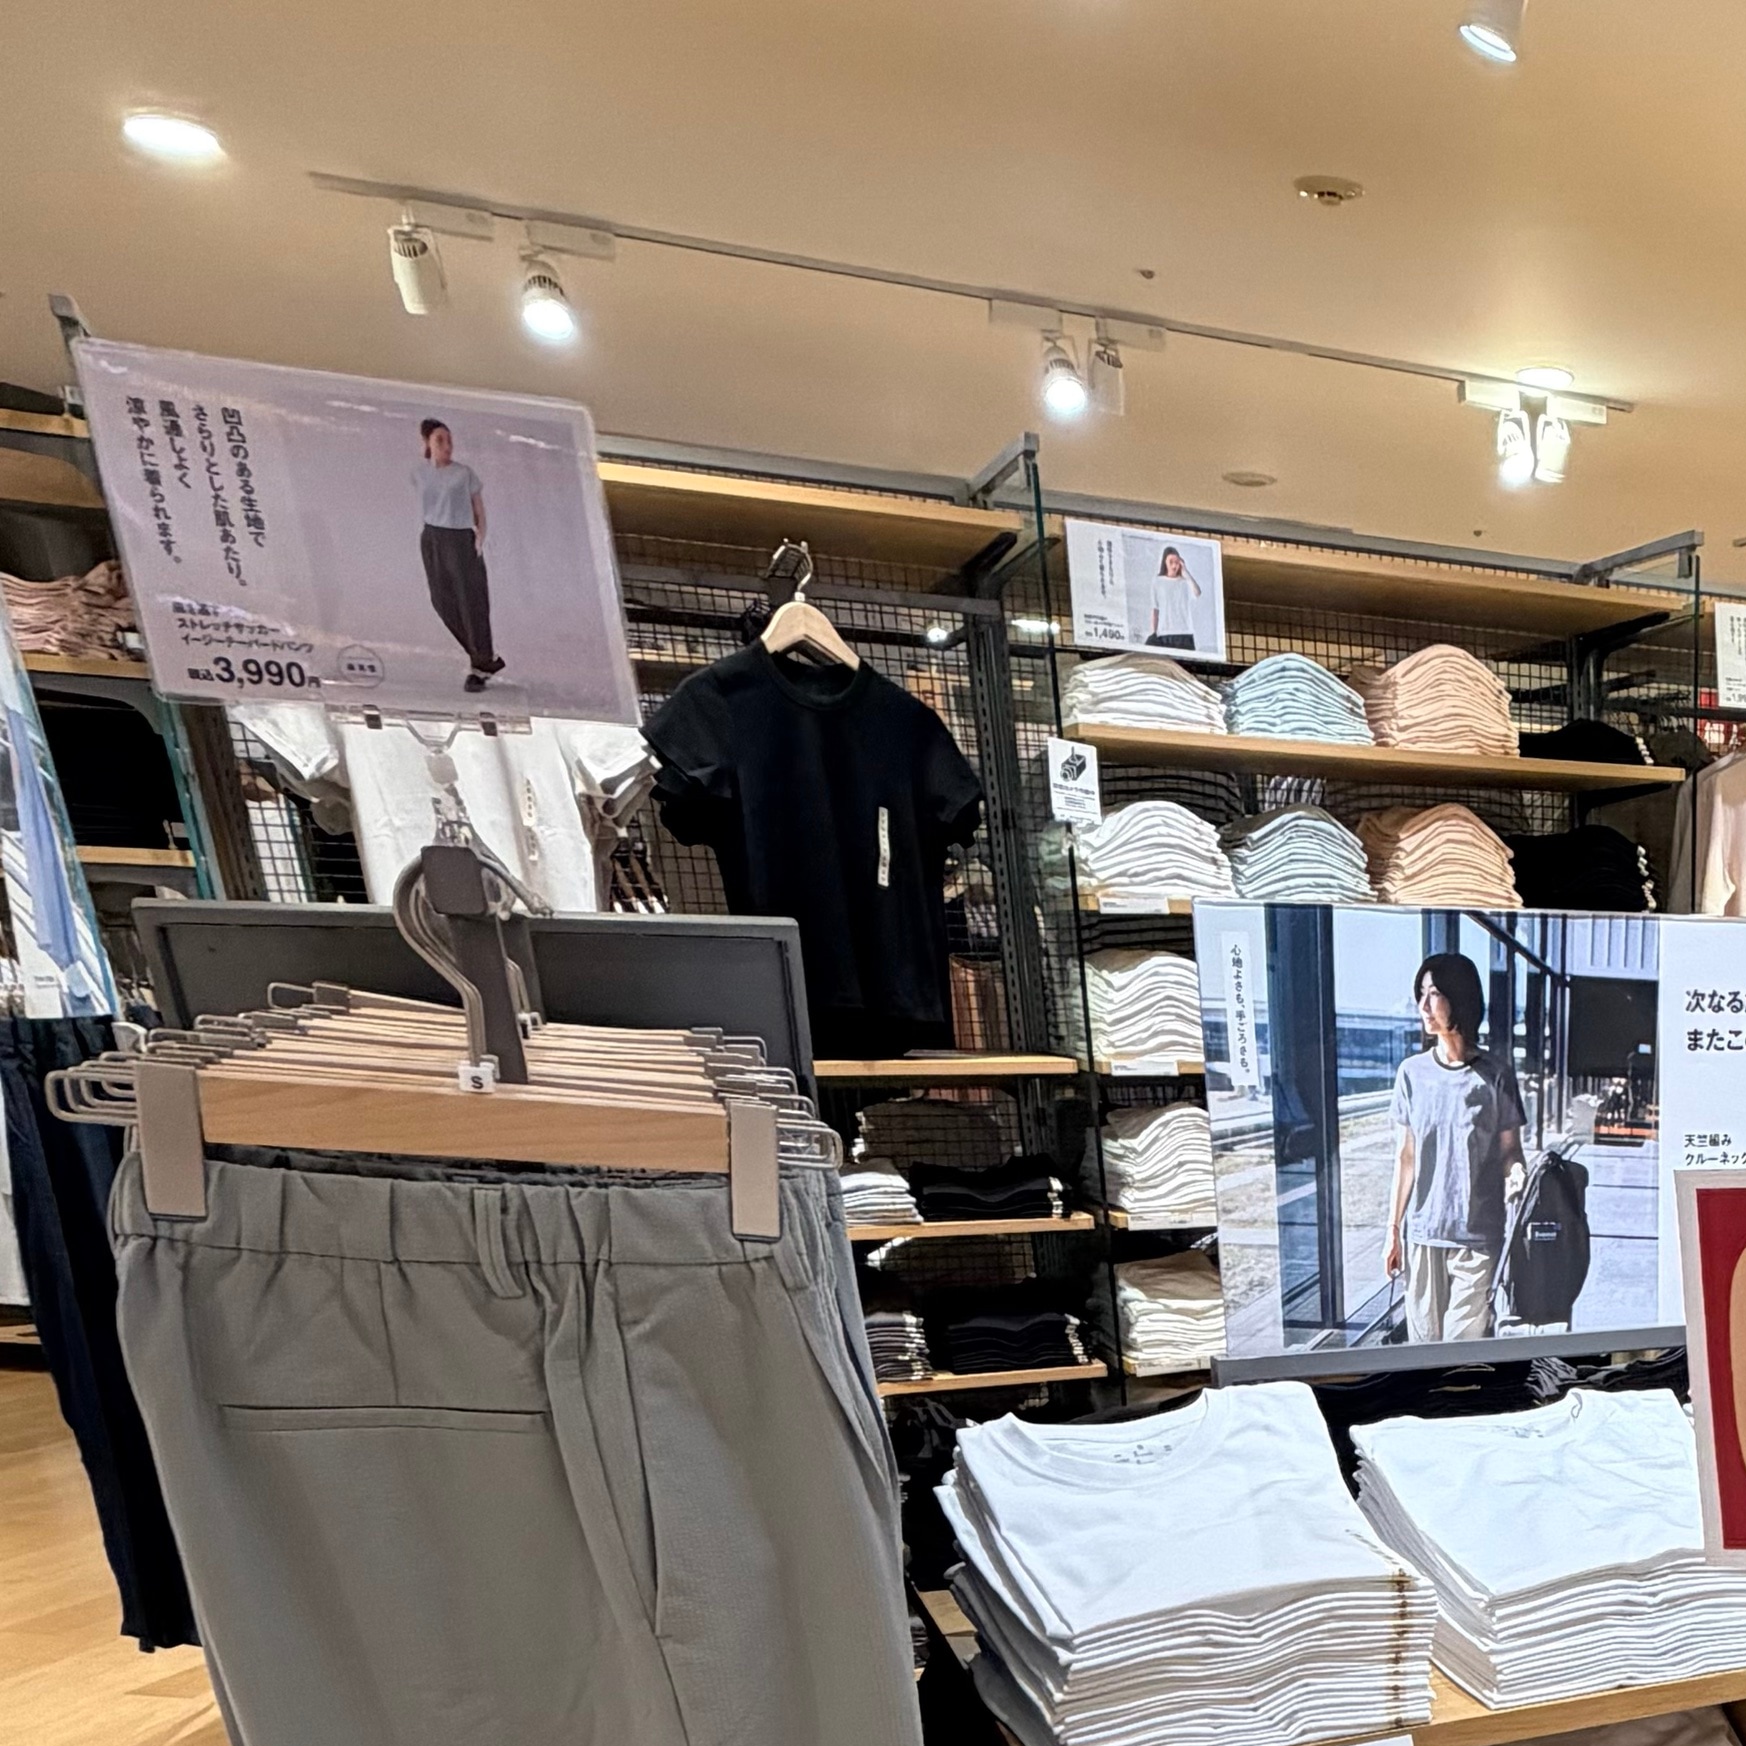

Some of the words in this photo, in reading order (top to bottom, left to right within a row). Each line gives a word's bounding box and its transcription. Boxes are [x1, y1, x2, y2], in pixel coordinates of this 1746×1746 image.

[126, 395, 182, 564] 涼やかに着られます。
[159, 399, 192, 489] 風通しよく
[192, 404, 247, 587] さらりとした肌あたり。
[221, 406, 266, 548] 凹凸のある生地で
[1230, 943, 1251, 1074] 心地よさも、手ごろさも。
[470, 1075, 484, 1090] S
[1684, 1133, 1732, 1148] 天竺編み
